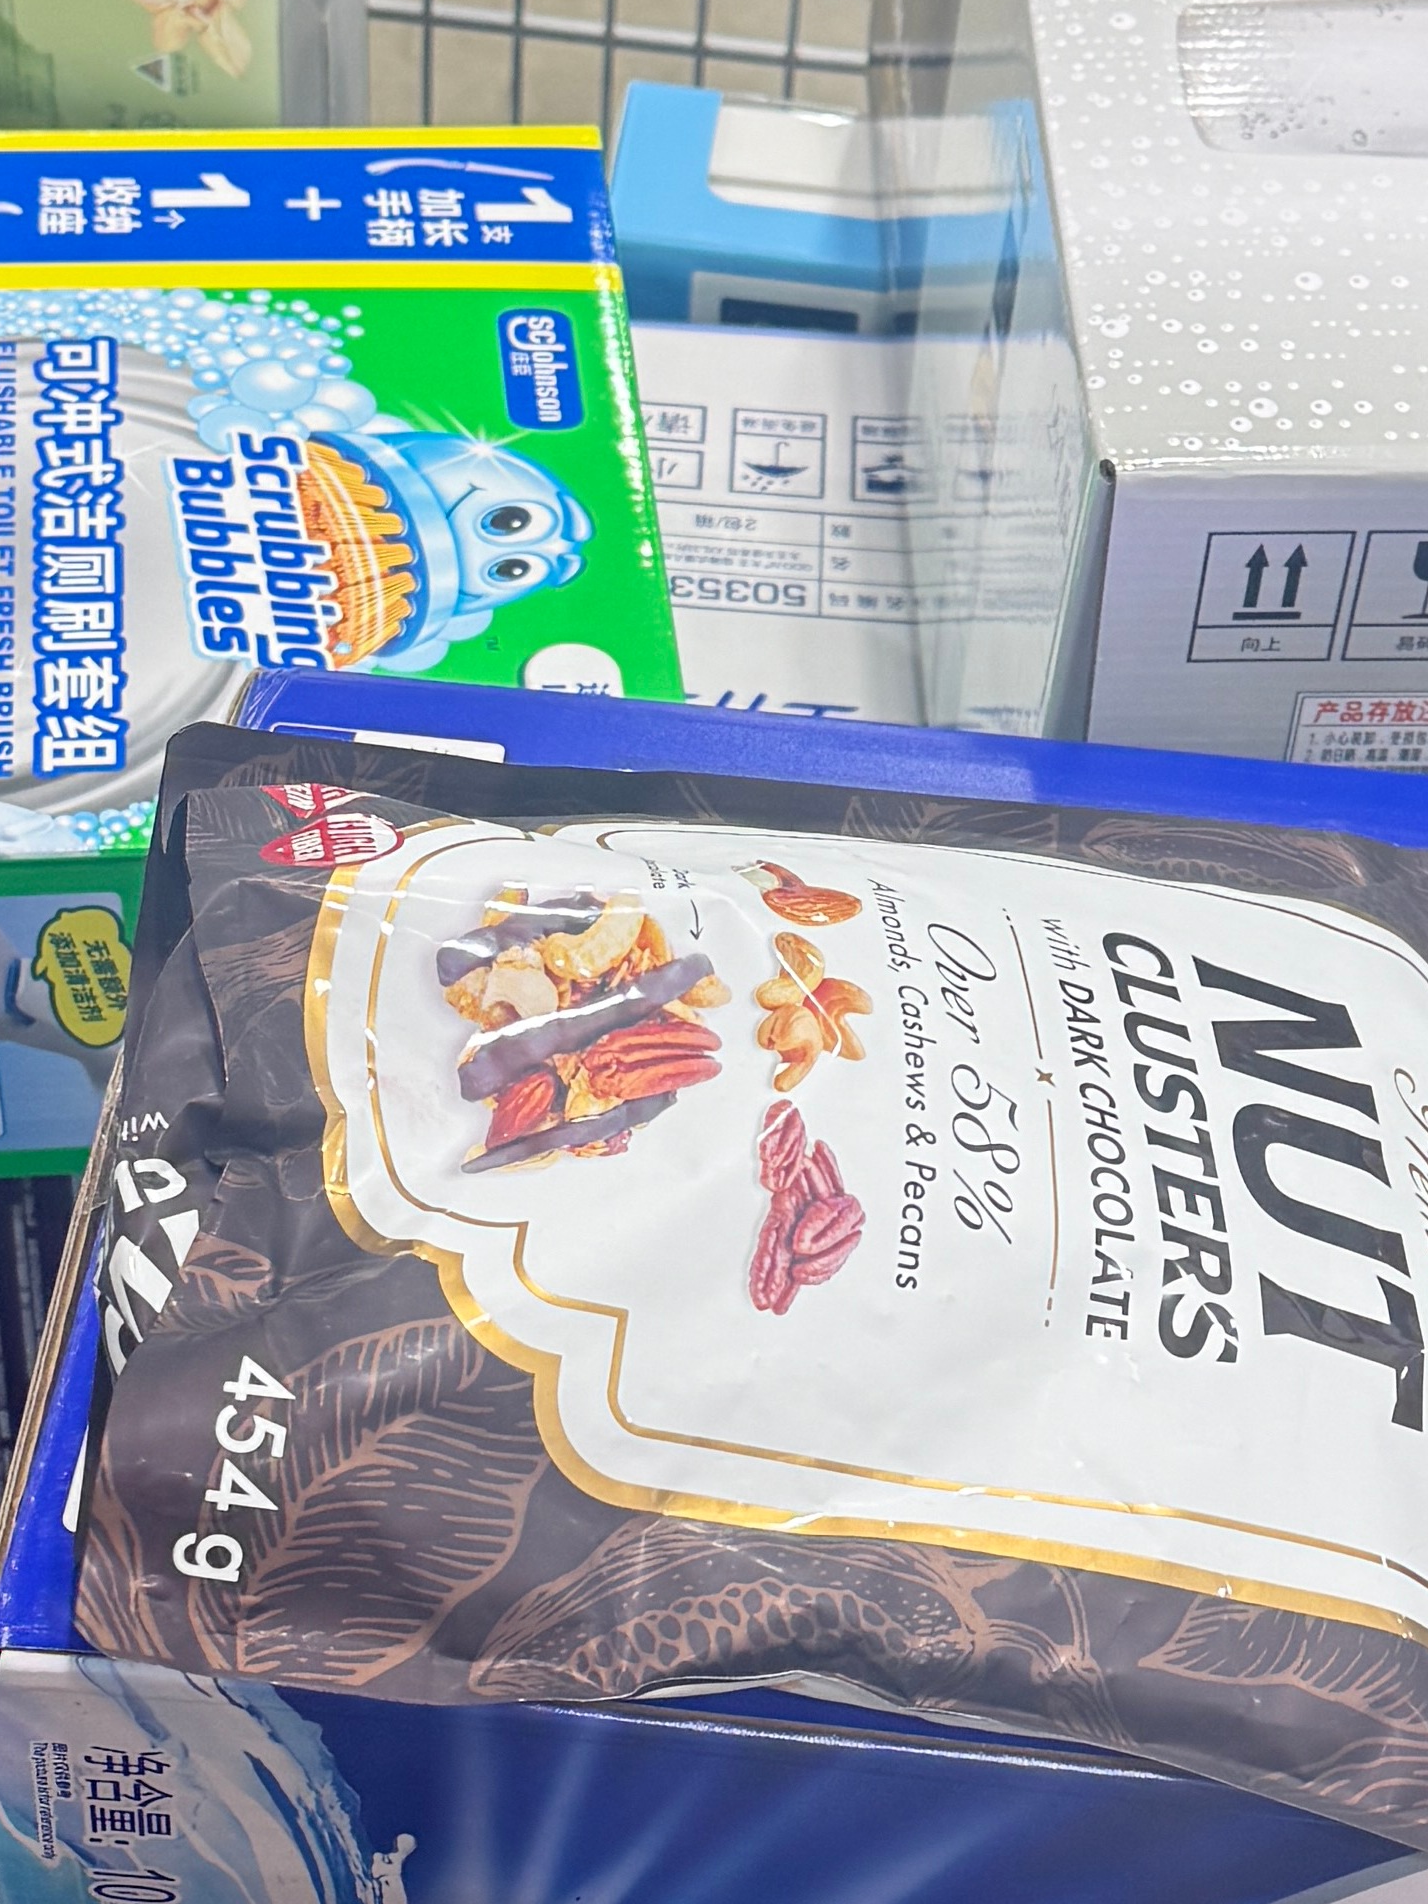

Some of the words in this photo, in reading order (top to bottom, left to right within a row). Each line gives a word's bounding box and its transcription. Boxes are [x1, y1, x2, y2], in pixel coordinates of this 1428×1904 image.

[38, 177, 89, 236] 底座
[92, 177, 143, 235] 收纳
[364, 187, 416, 248] 手柄
[417, 188, 470, 247] 加长
[34, 337, 122, 776] 可冲式洁厕刷套组
[171, 456, 251, 656] Bubbles
[239, 431, 337, 670] Scrubbing
[1239, 635, 1282, 655] 向上
[290, 829, 325, 863] FIBER
[867, 877, 923, 973] Almonds,
[926, 921, 998, 1046] Over
[1041, 918, 1080, 972] with
[896, 982, 930, 1113] Cashews
[1059, 979, 1111, 1097] DARK
[904, 1121, 937, 1148] &
[950, 1063, 1023, 1246] 58%
[1101, 931, 1239, 1364] CLUSTERS
[1190, 954, 1425, 1433] NUT
[895, 1157, 936, 1292] Pecans
[1078, 1082, 1137, 1343] CHOCOLATE
[204, 1354, 298, 1514] 454
[172, 1531, 246, 1584] g
[84, 1744, 174, 1844] 净含量:
